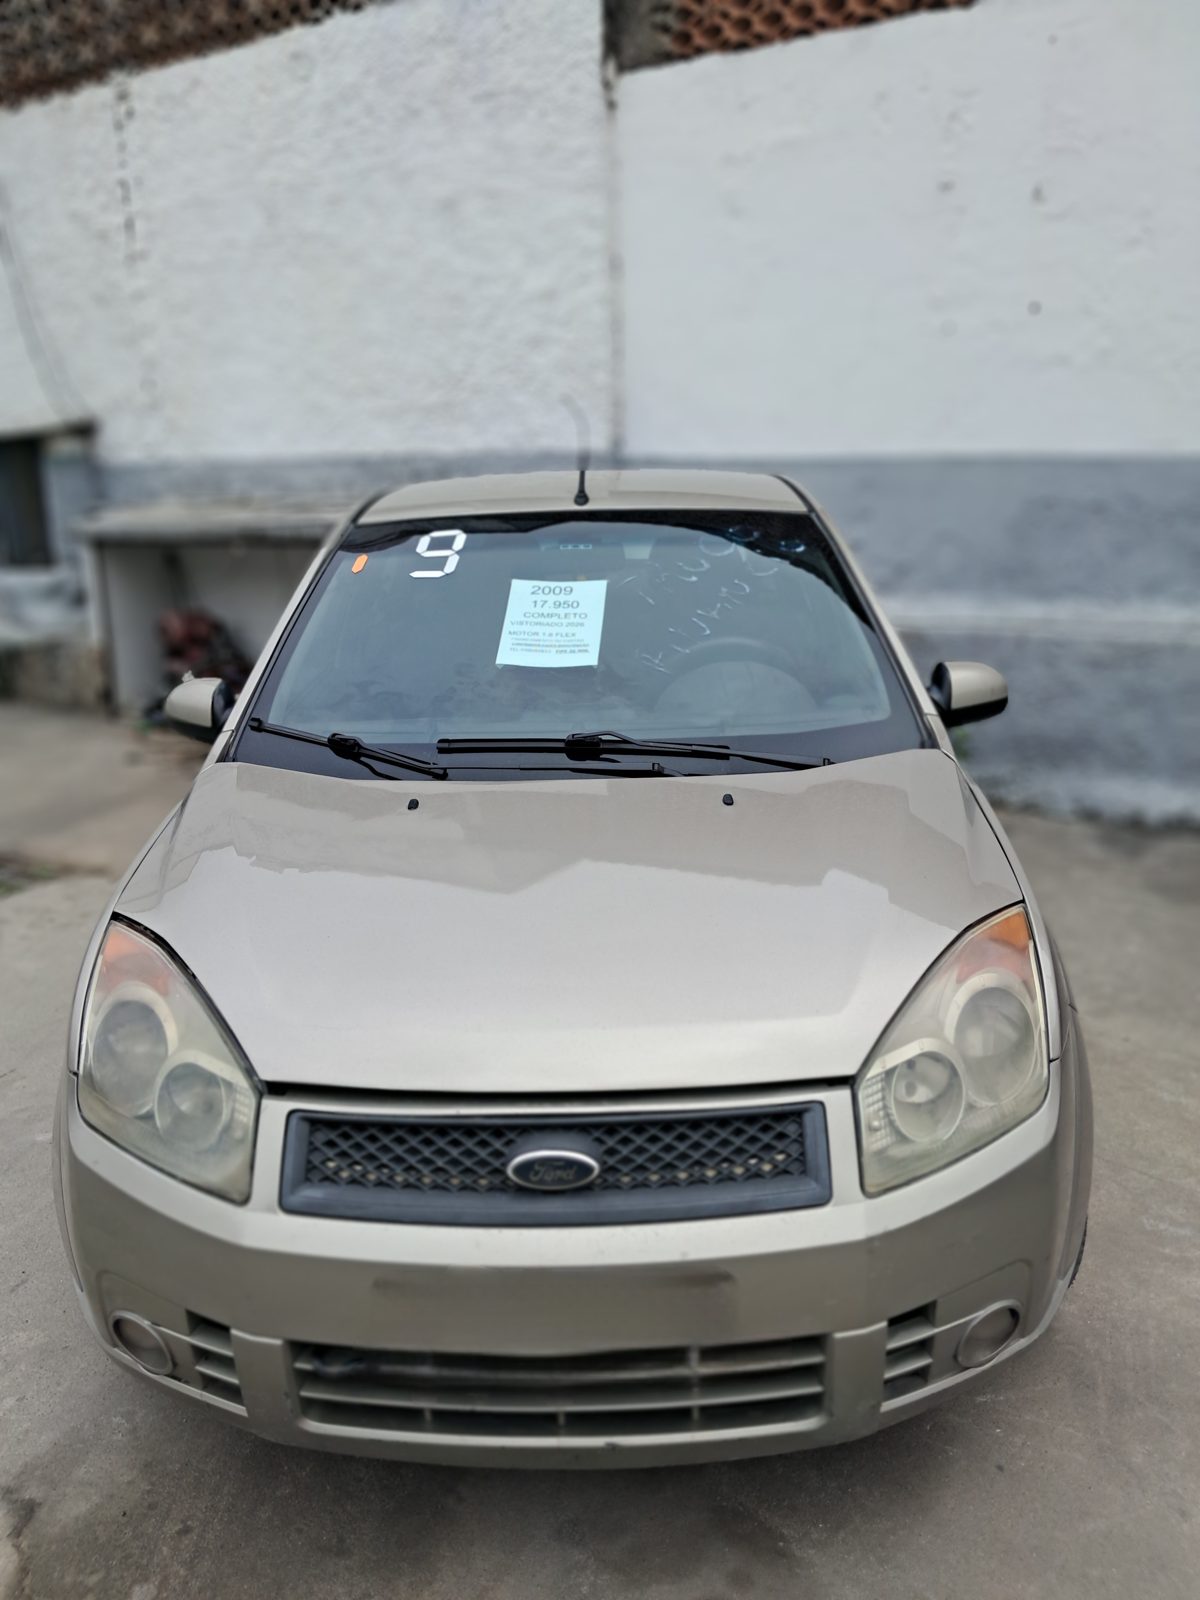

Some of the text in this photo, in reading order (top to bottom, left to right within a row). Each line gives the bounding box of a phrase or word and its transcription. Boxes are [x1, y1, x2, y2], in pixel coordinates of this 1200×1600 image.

[530, 585, 574, 596] 2009
[532, 600, 580, 609] 17.950
[523, 611, 588, 620] COMPLETO
[510, 620, 564, 628] VISTORIADO
[529, 1162, 577, 1182] Ford
